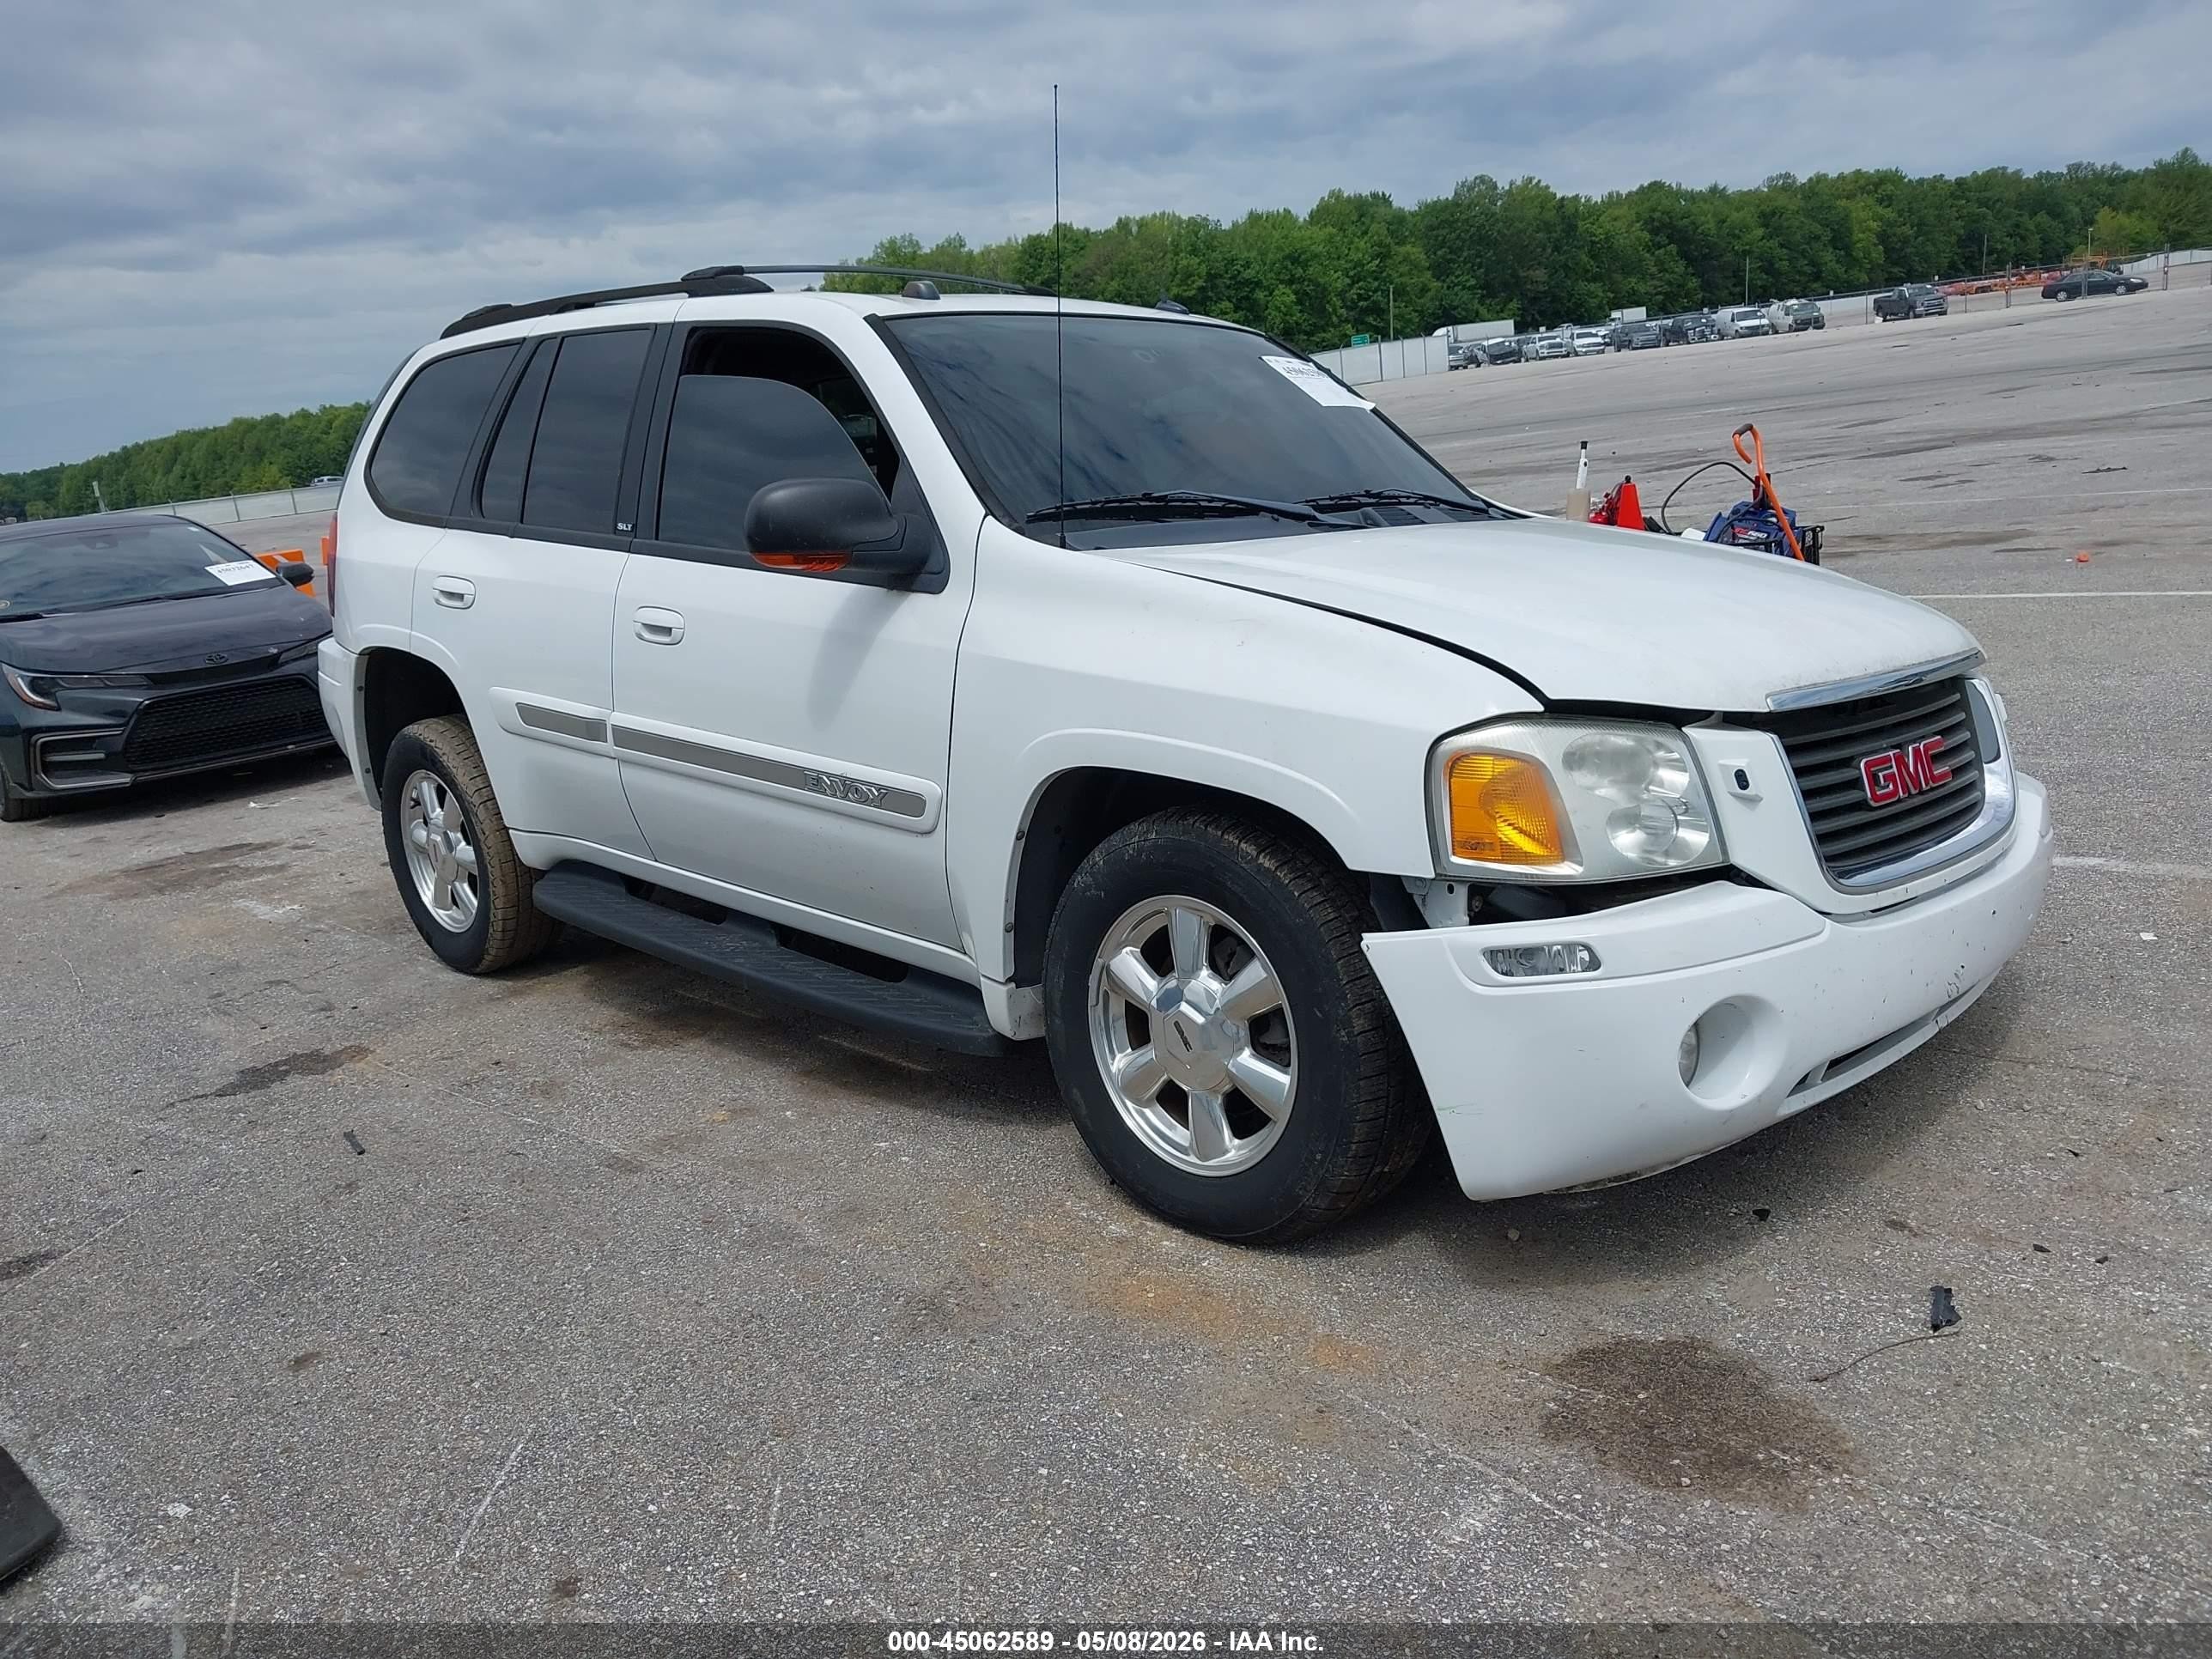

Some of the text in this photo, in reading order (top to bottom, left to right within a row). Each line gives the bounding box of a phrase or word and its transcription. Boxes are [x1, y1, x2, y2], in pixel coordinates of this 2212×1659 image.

[617, 522, 633, 532] SLT
[804, 771, 888, 808] ENVOY
[1860, 735, 1953, 807] GMC
